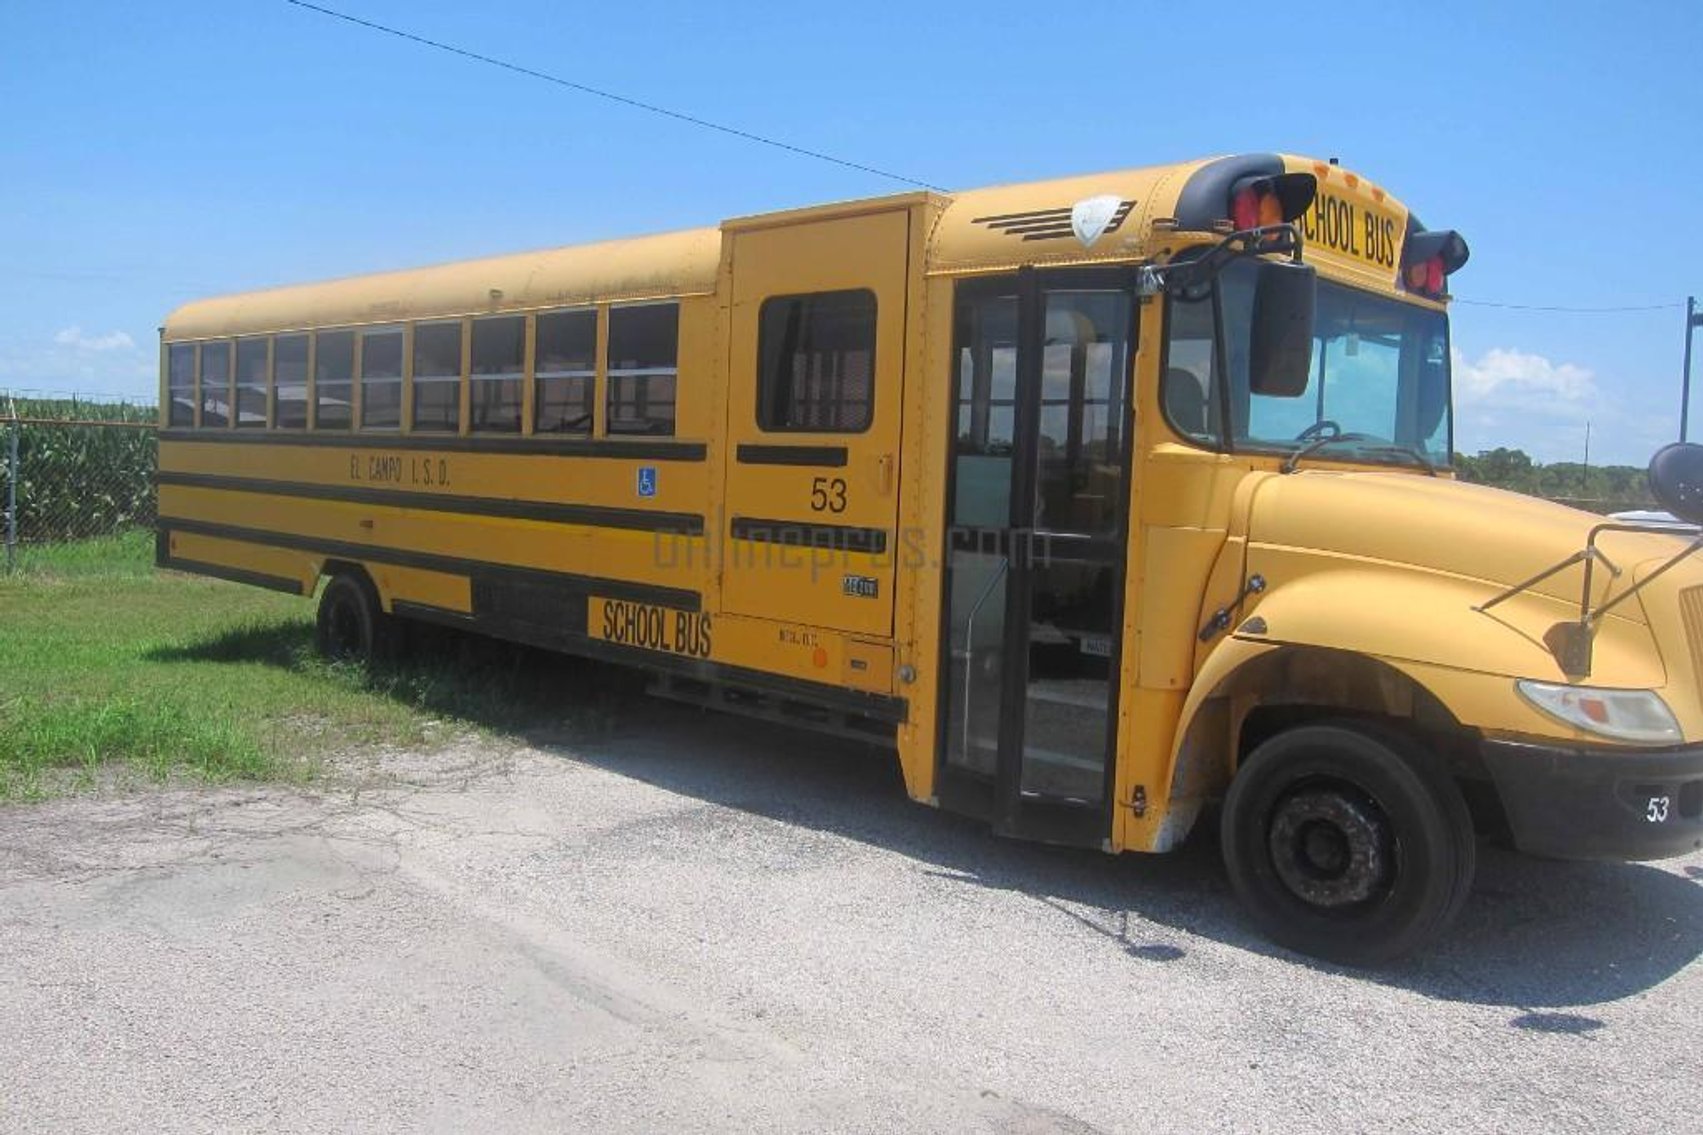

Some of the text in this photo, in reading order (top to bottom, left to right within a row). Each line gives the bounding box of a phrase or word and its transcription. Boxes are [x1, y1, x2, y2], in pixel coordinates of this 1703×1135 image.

[1301, 190, 1394, 268] CHOOL BUS
[350, 454, 360, 480] EL
[368, 456, 401, 482] CAMPO
[811, 477, 847, 513] 53
[604, 600, 711, 658] SCHOOL BUS
[1646, 796, 1670, 822] 53
